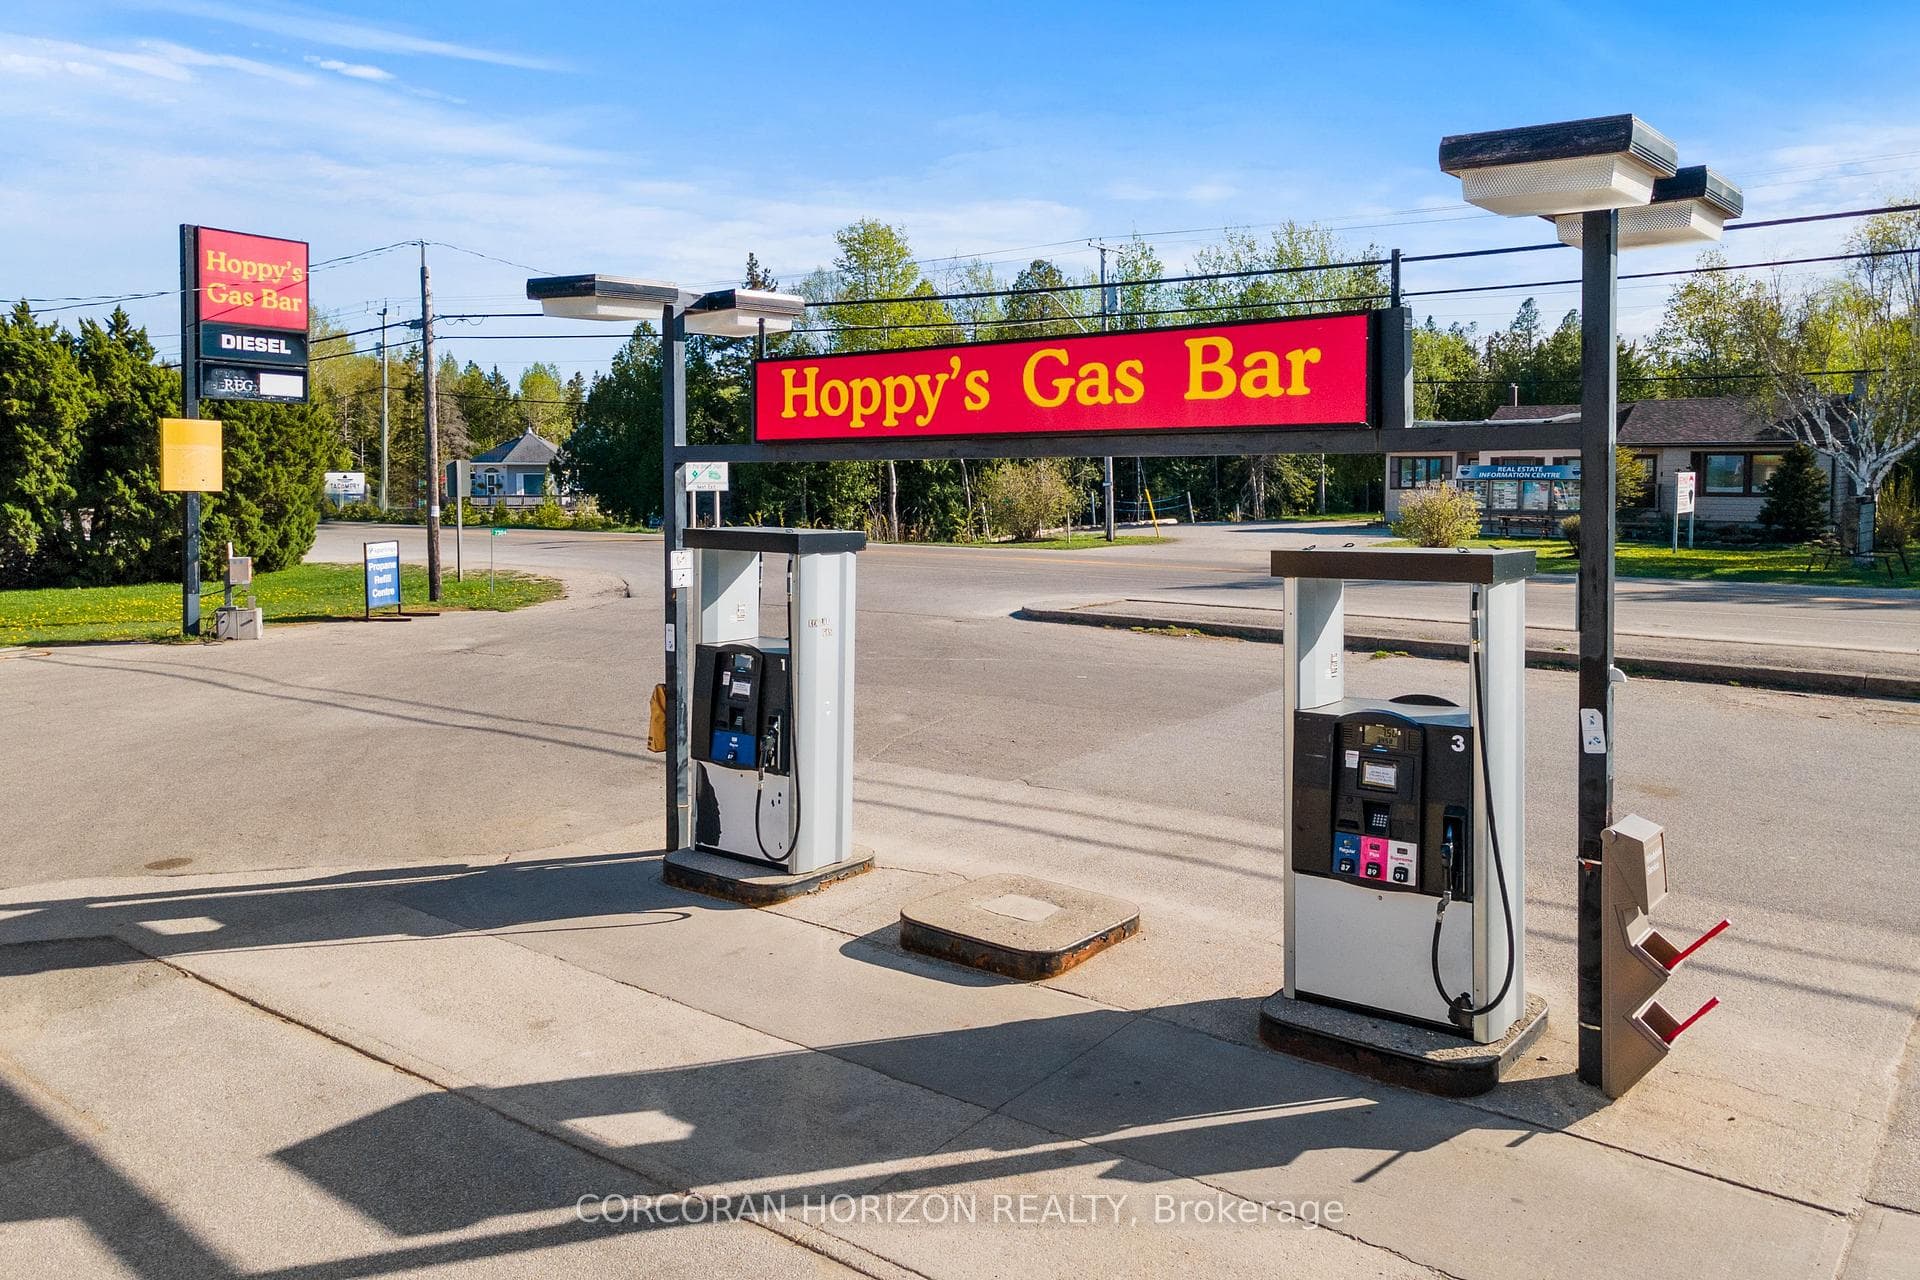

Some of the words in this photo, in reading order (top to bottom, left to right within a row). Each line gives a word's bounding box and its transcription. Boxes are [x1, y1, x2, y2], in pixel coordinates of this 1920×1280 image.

[206, 249, 303, 284] Hoppy's
[206, 282, 254, 307] Gas
[261, 288, 303, 313] Bar
[221, 333, 292, 355] DIESEL
[223, 378, 254, 392] REG
[780, 355, 990, 429] Hoppy's
[1022, 347, 1146, 409] Gas
[1183, 336, 1322, 401] Bar
[368, 562, 396, 572] Propane
[372, 588, 395, 598] Centre
[781, 658, 786, 671] 1
[1451, 734, 1465, 752] 3
[1340, 863, 1351, 871] 87
[1367, 868, 1378, 876] 89
[1394, 872, 1404, 880] 91
